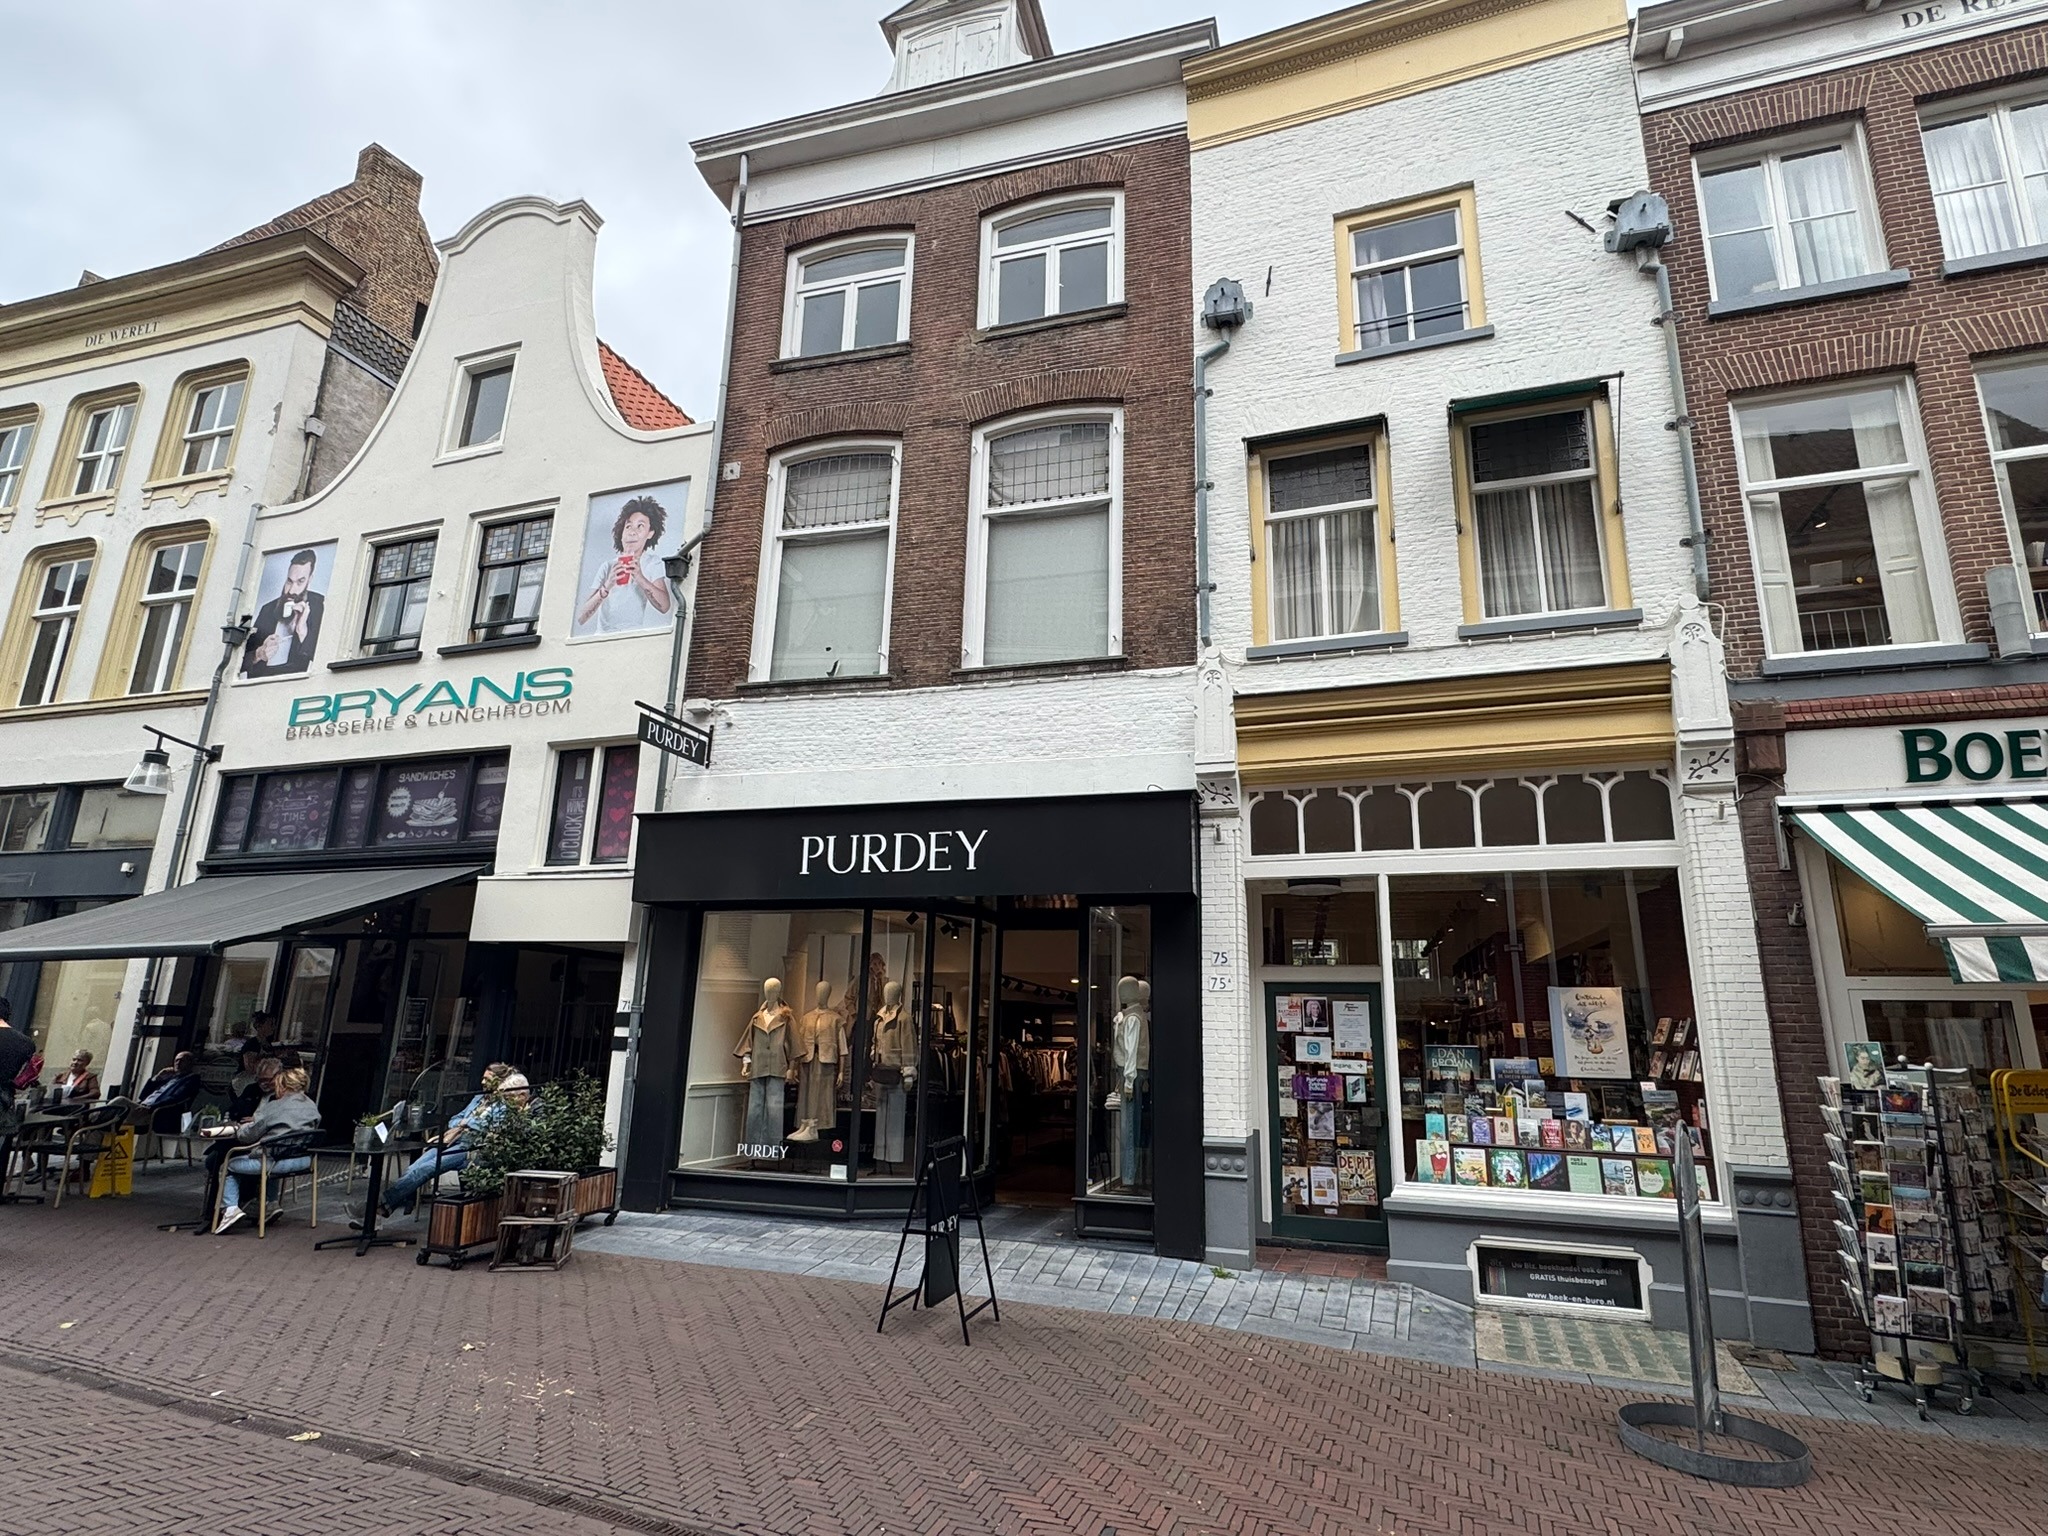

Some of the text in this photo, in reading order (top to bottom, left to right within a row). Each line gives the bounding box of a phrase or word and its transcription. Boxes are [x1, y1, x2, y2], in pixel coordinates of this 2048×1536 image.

[1901, 4, 1946, 29] DE
[85, 321, 160, 347] DIE WERELT
[288, 667, 573, 727] BRYANS
[286, 698, 572, 740] BRASSERIE & LUNCHROOM
[647, 721, 699, 758] PURDEY
[1898, 728, 2048, 784] BOE
[398, 769, 456, 783] SANDWICHES
[567, 799, 585, 814] WINE
[281, 811, 306, 821] TIME
[561, 815, 583, 859] O'CLOCK
[799, 829, 988, 875] PURDEY
[1213, 952, 1228, 963] 75
[1437, 1048, 1465, 1059] DAN
[1431, 1058, 1473, 1069] BROWN
[736, 1143, 789, 1159] PURDEY
[1340, 1156, 1373, 1170] DE PIT
[1529, 1273, 1607, 1287] GRATIS thuisbezorgd!
[1527, 1291, 1616, 1306] www.boek-en-buro.nl
